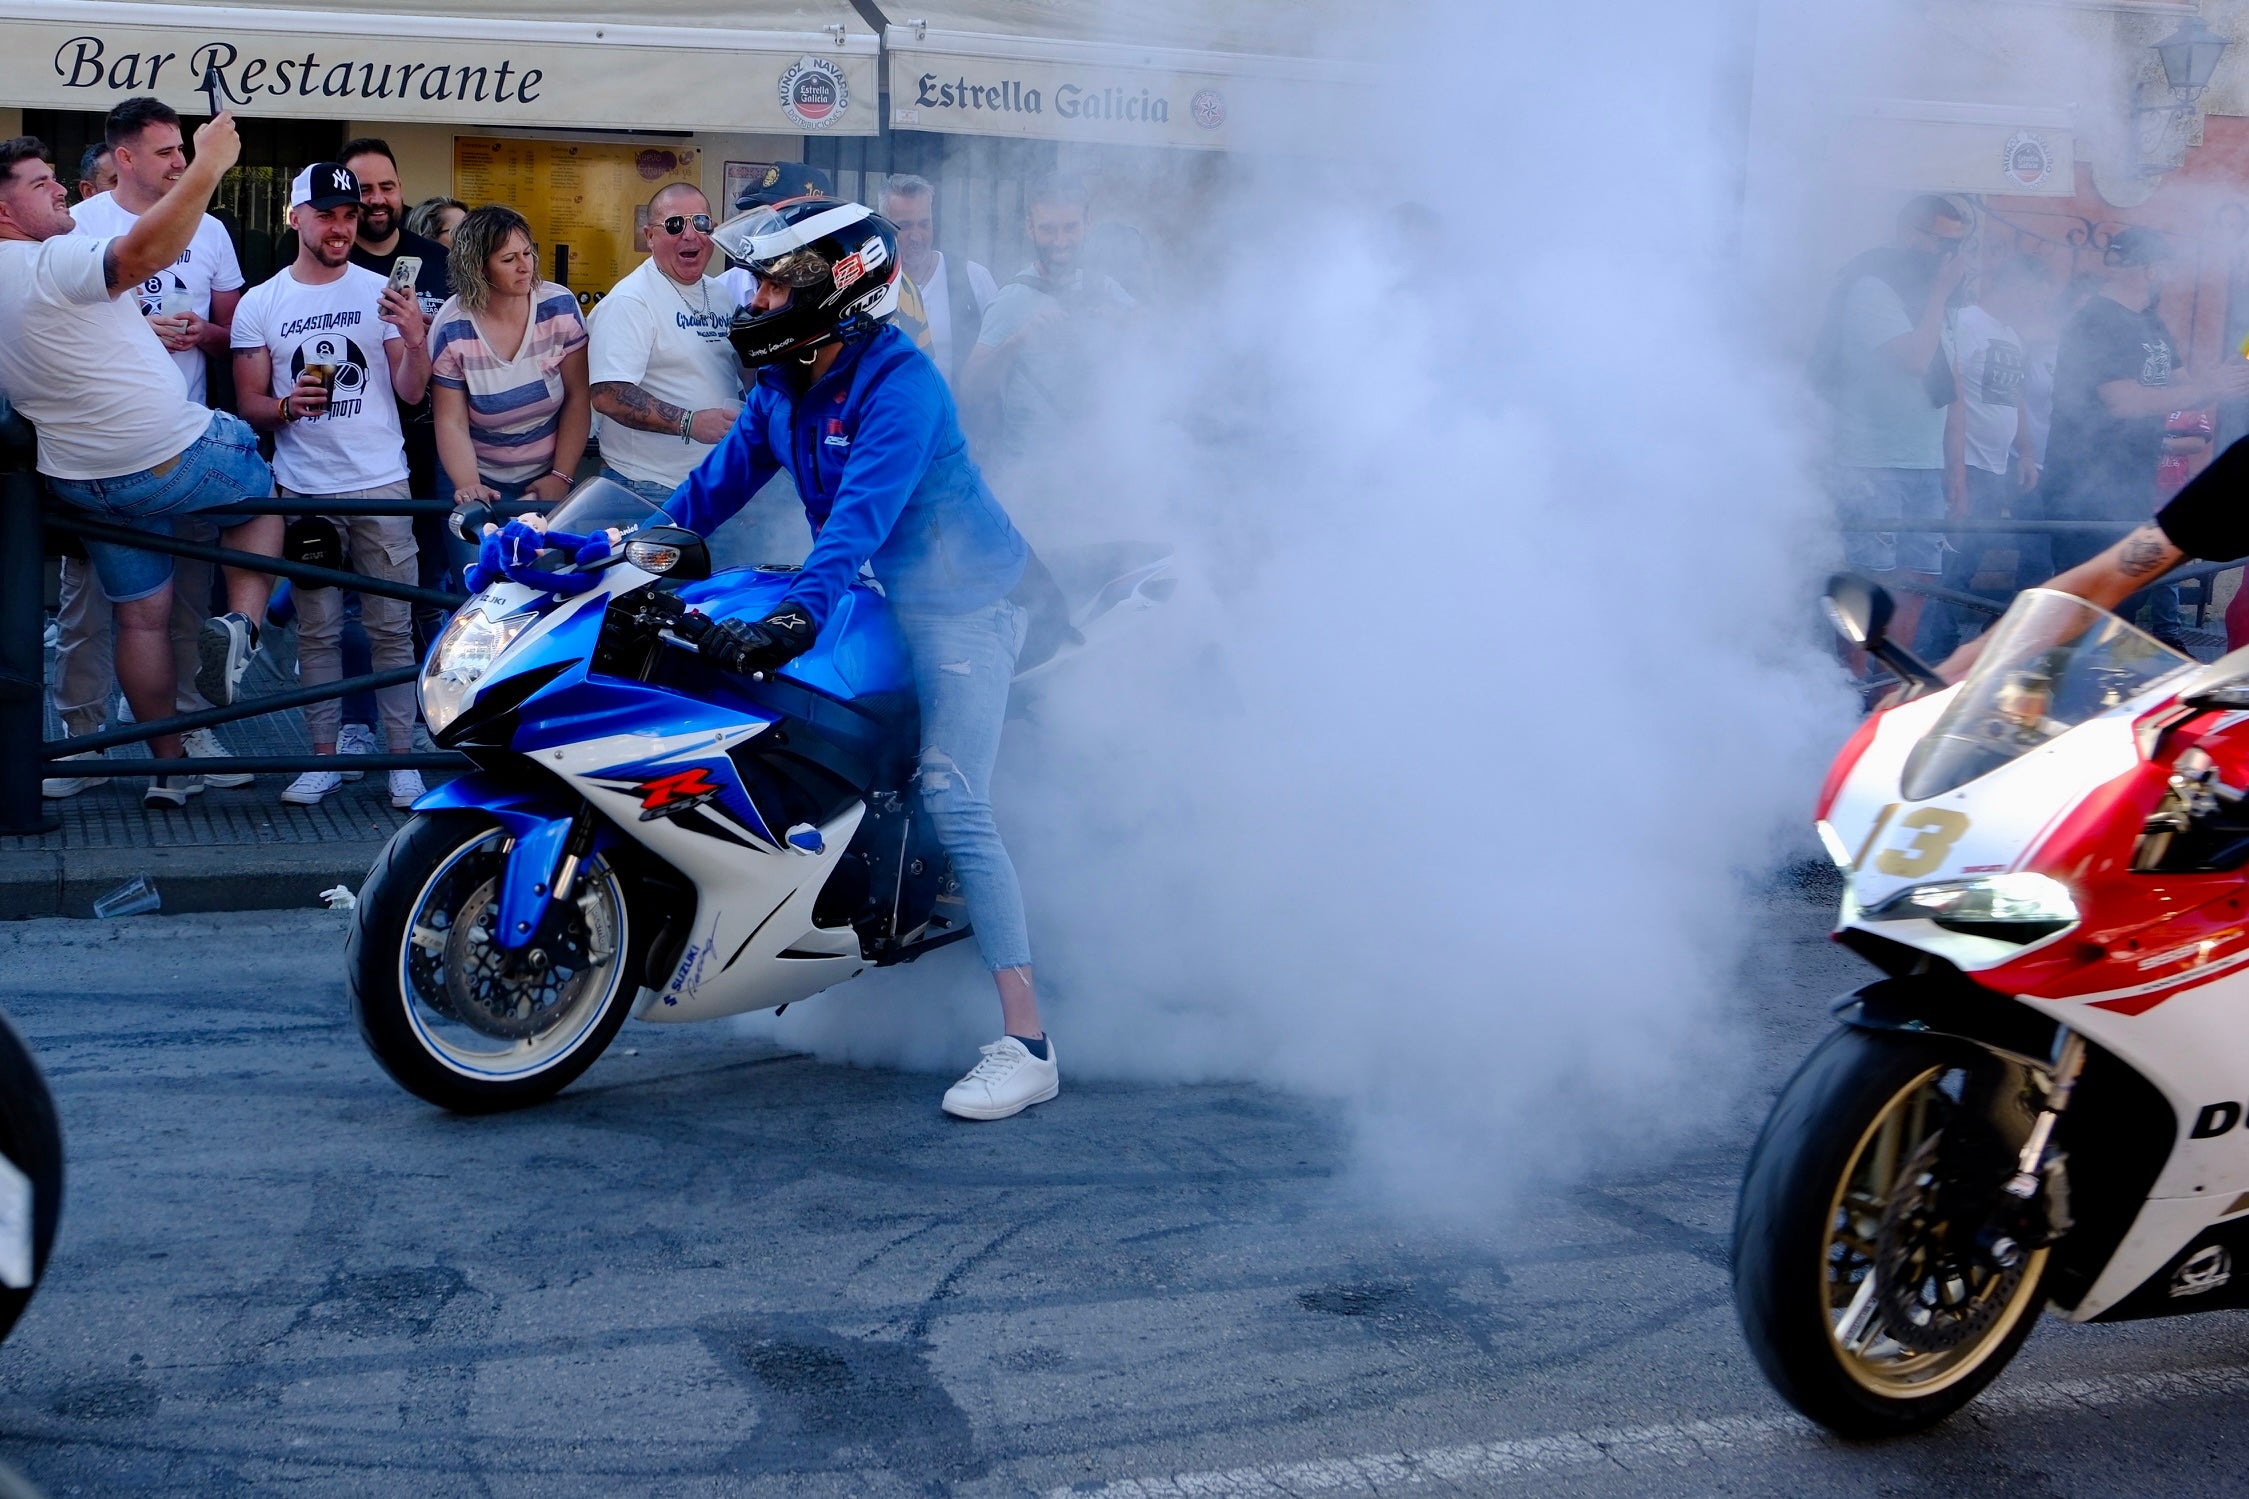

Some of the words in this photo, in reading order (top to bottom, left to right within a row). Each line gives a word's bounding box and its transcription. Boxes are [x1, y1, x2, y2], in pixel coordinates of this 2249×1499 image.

[55, 36, 175, 90] Bar
[190, 42, 544, 105] Restaurante
[780, 62, 804, 107] MUÑOZ
[813, 59, 849, 108] NAVARRO
[800, 85, 830, 95] Estrella
[800, 94, 829, 104] Galicia
[914, 72, 1042, 114] Estrella
[1055, 83, 1169, 124] Galicia
[787, 108, 842, 130] DISTRIBUCIONES
[148, 278, 159, 292] 8
[280, 310, 362, 339] CASASIMARRO
[328, 398, 362, 421] MOTO
[1853, 803, 1973, 879] 13
[671, 944, 700, 992] SUZUKI
[2188, 1101, 2249, 1140] D
